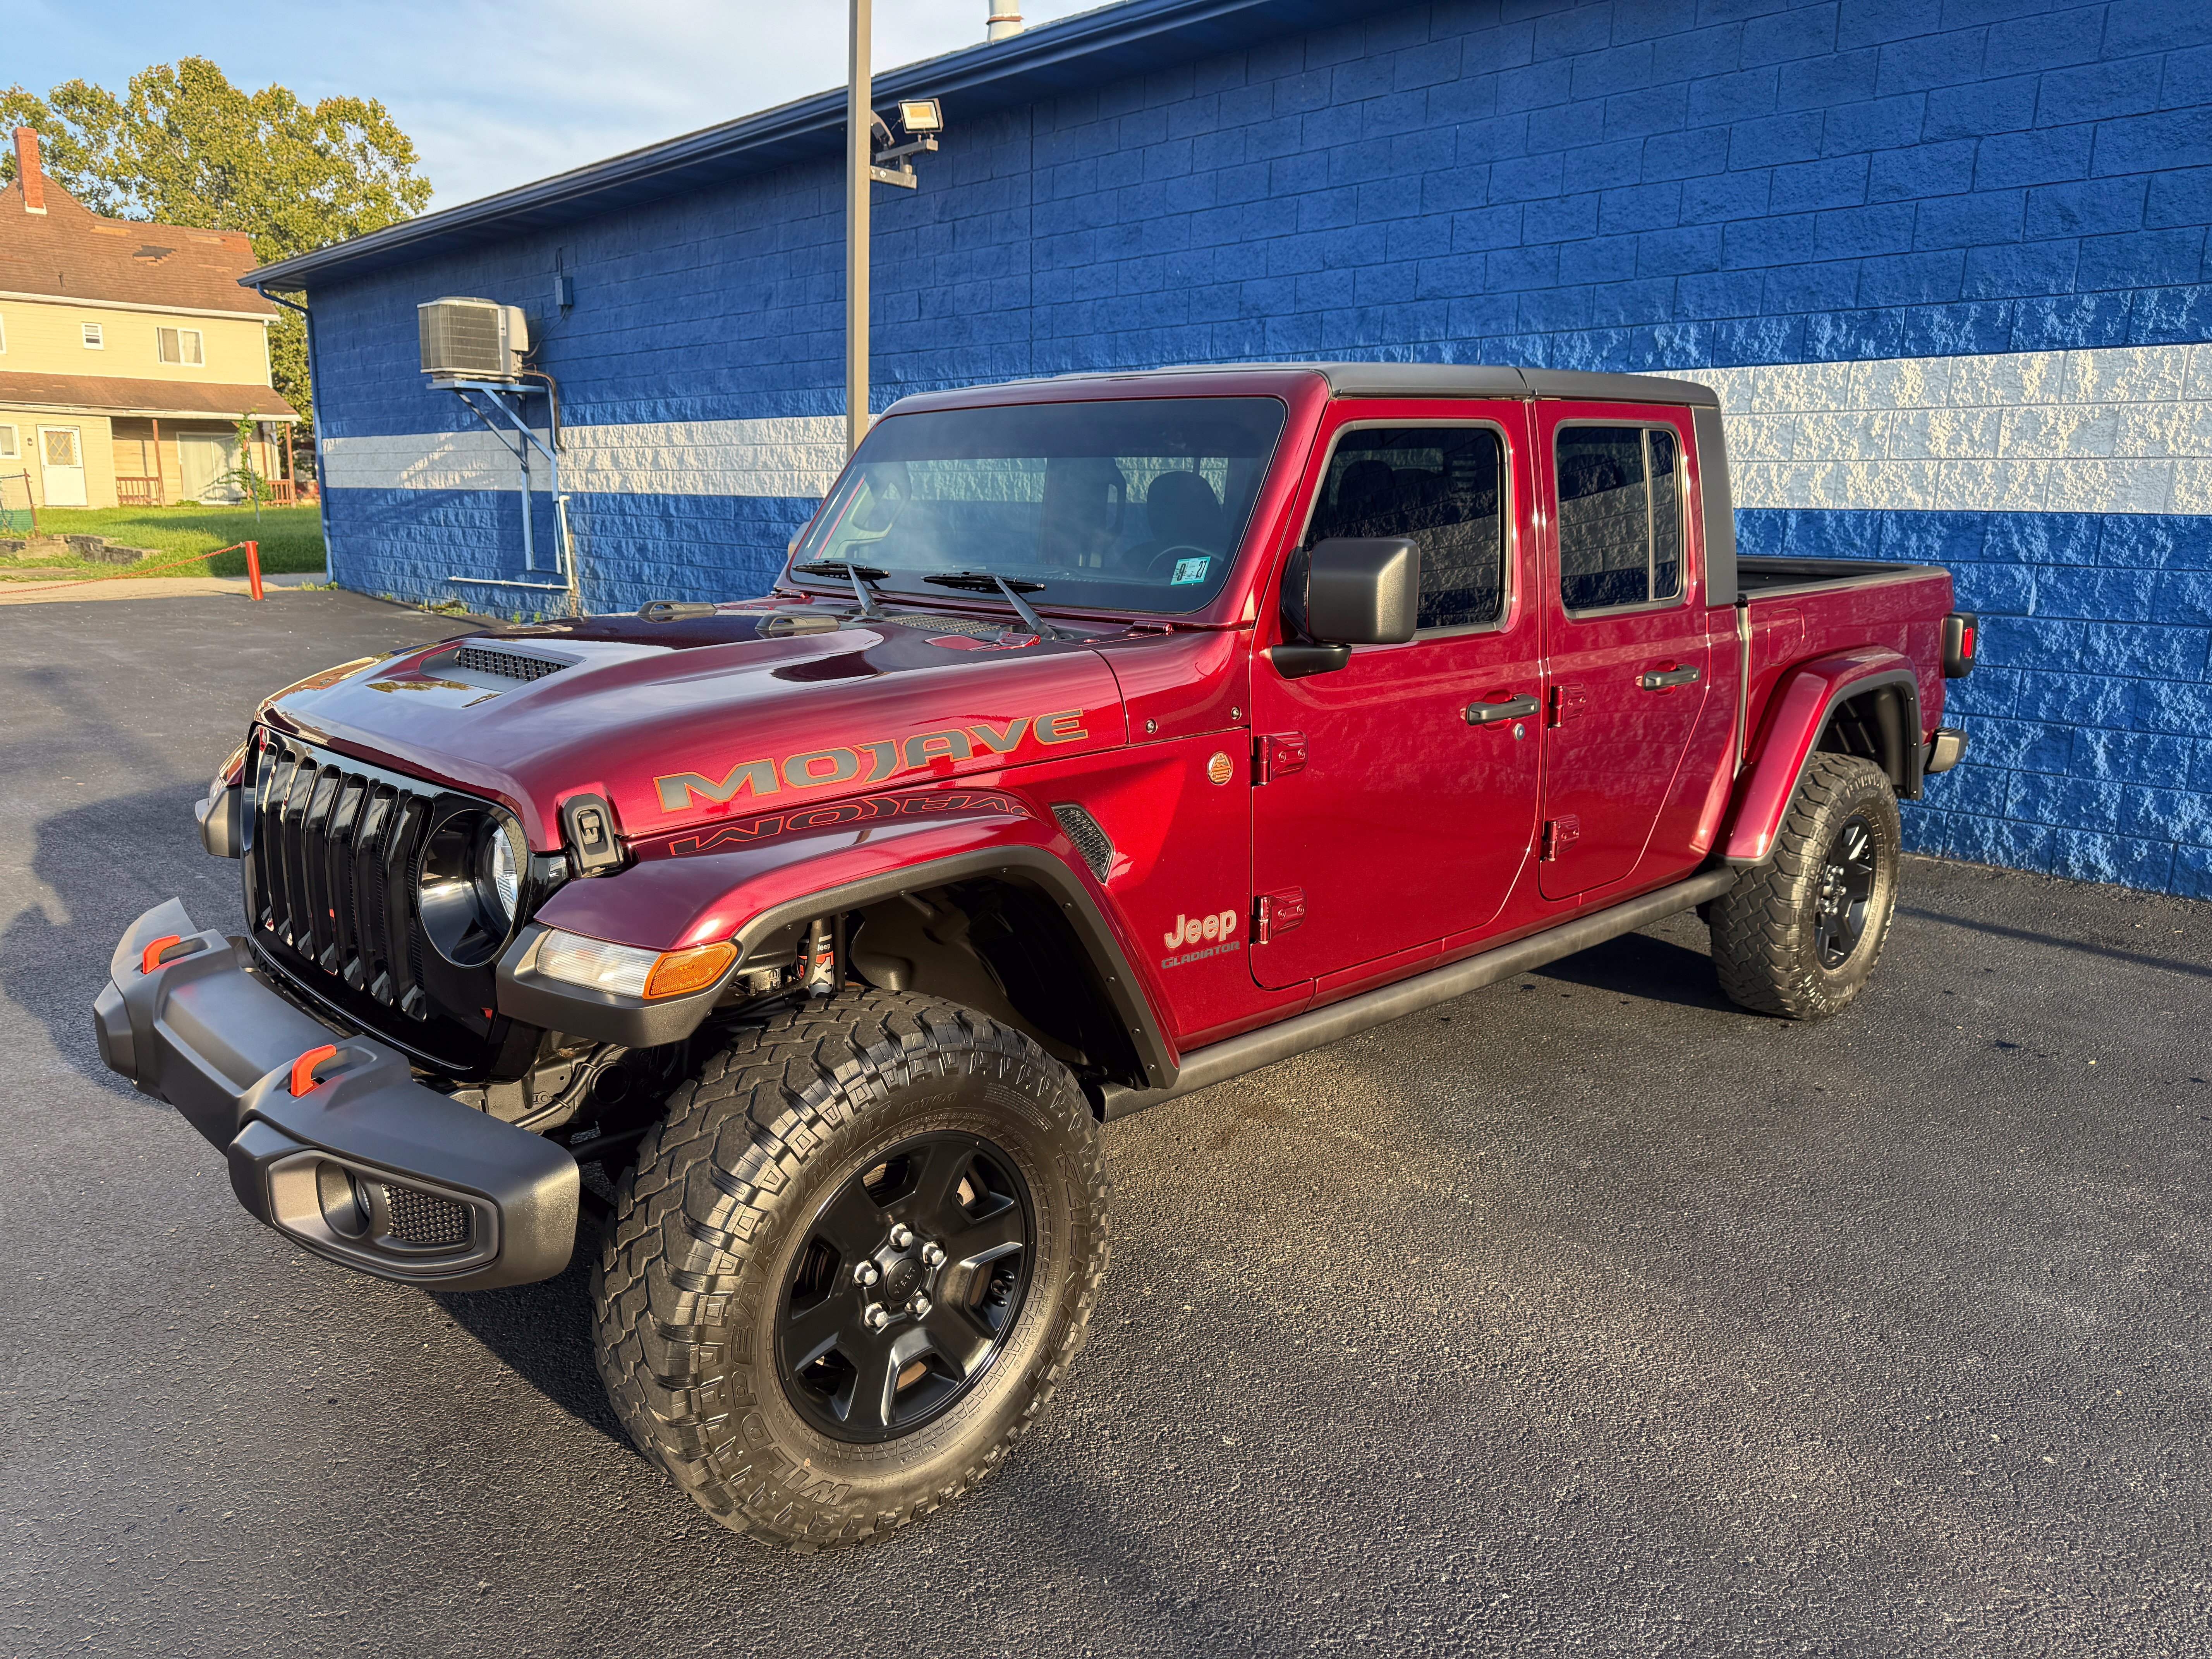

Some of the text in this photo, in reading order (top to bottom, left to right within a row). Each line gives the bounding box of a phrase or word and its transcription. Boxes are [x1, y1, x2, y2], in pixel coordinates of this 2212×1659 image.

[1195, 560, 1207, 578] 27
[653, 708, 1089, 814] MOJAVE
[1164, 910, 1237, 948] Jeep
[1162, 940, 1240, 969] GLADIATOR
[1024, 1144, 1088, 1392] FALKEN
[1029, 1321, 1039, 1338] LOAD
[1018, 1339, 1031, 1358] RANGE
